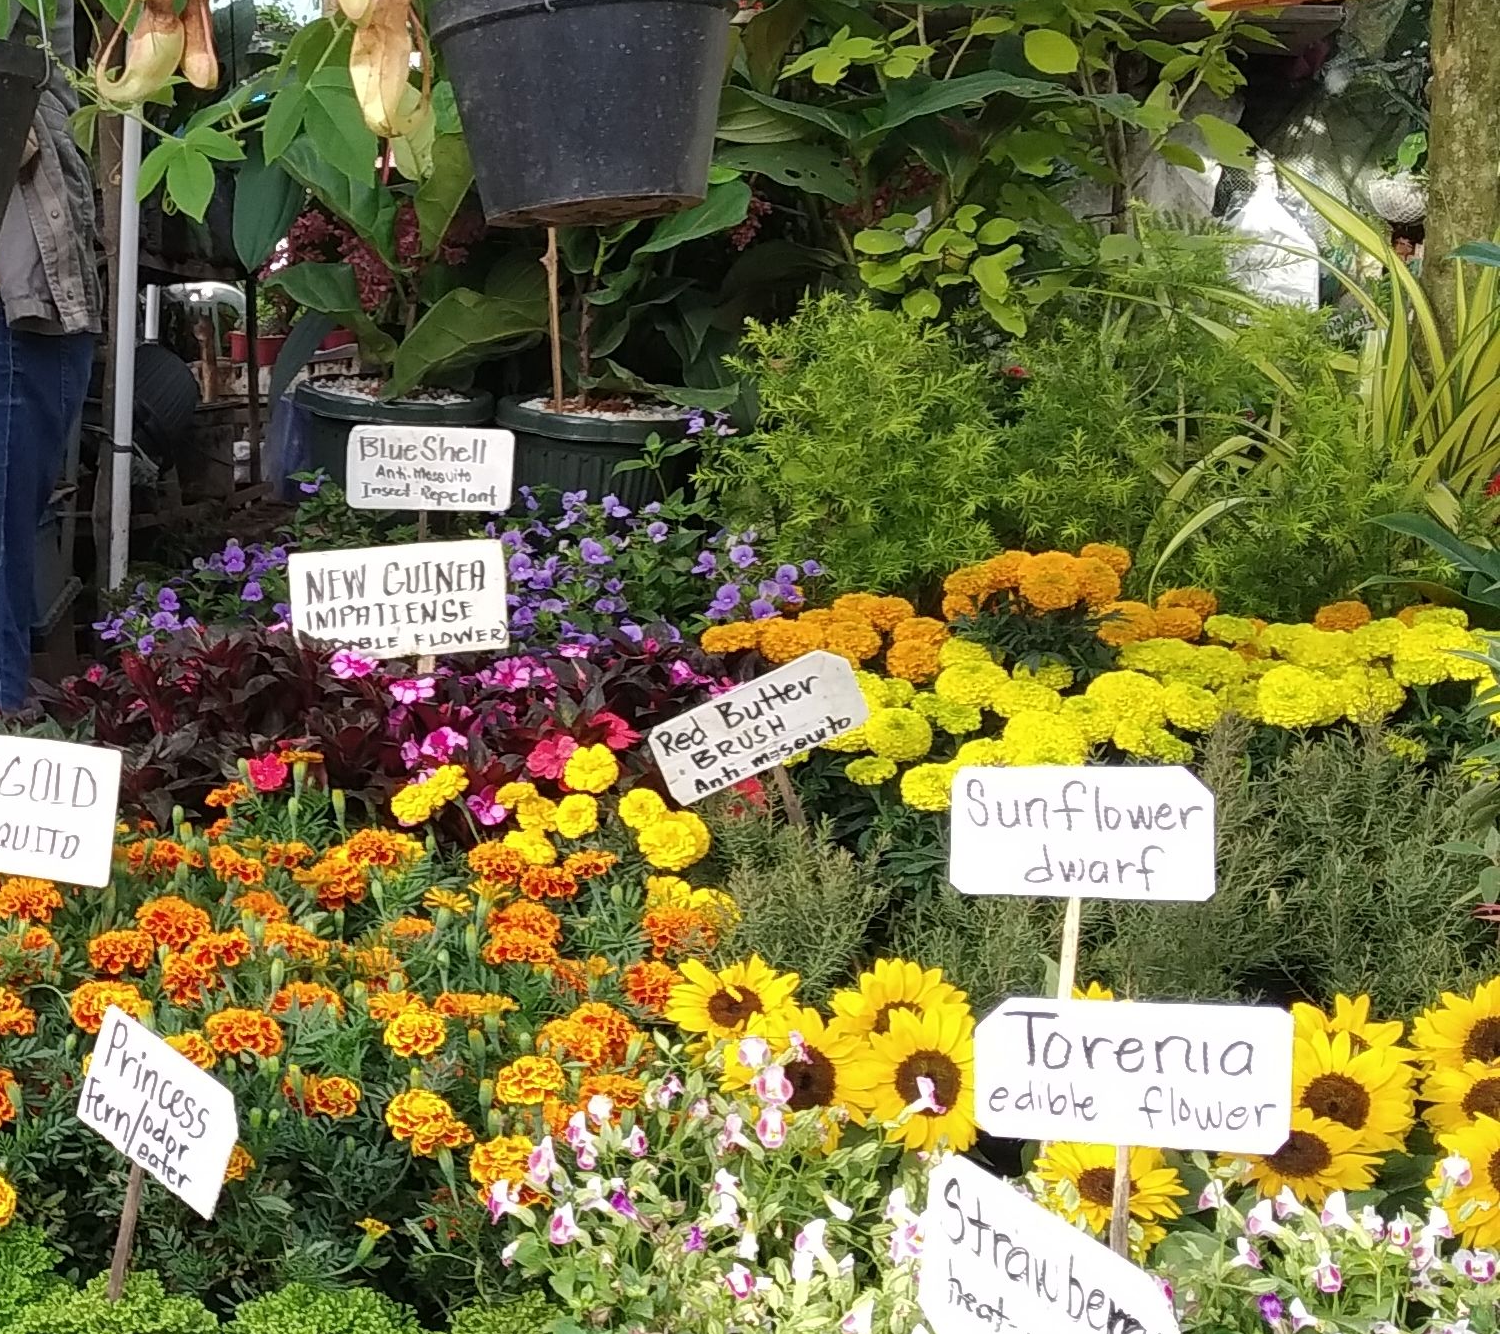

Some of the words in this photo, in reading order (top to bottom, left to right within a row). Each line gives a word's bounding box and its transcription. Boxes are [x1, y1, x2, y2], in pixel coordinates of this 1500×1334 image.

[305, 563, 367, 606] NEW
[383, 560, 486, 596] GUINEA
[306, 599, 474, 631] IMPATIENSE
[655, 715, 708, 756] Red
[714, 675, 819, 729] Butter
[690, 715, 787, 770] BRUSH
[967, 779, 1203, 832] Sunflower
[1024, 845, 1165, 891] dwarf
[1003, 1011, 1255, 1075] Torenia
[104, 1019, 210, 1138] Princess
[988, 1081, 1098, 1121] edible
[1139, 1086, 1277, 1130] flower
[136, 1143, 192, 1188] eater
